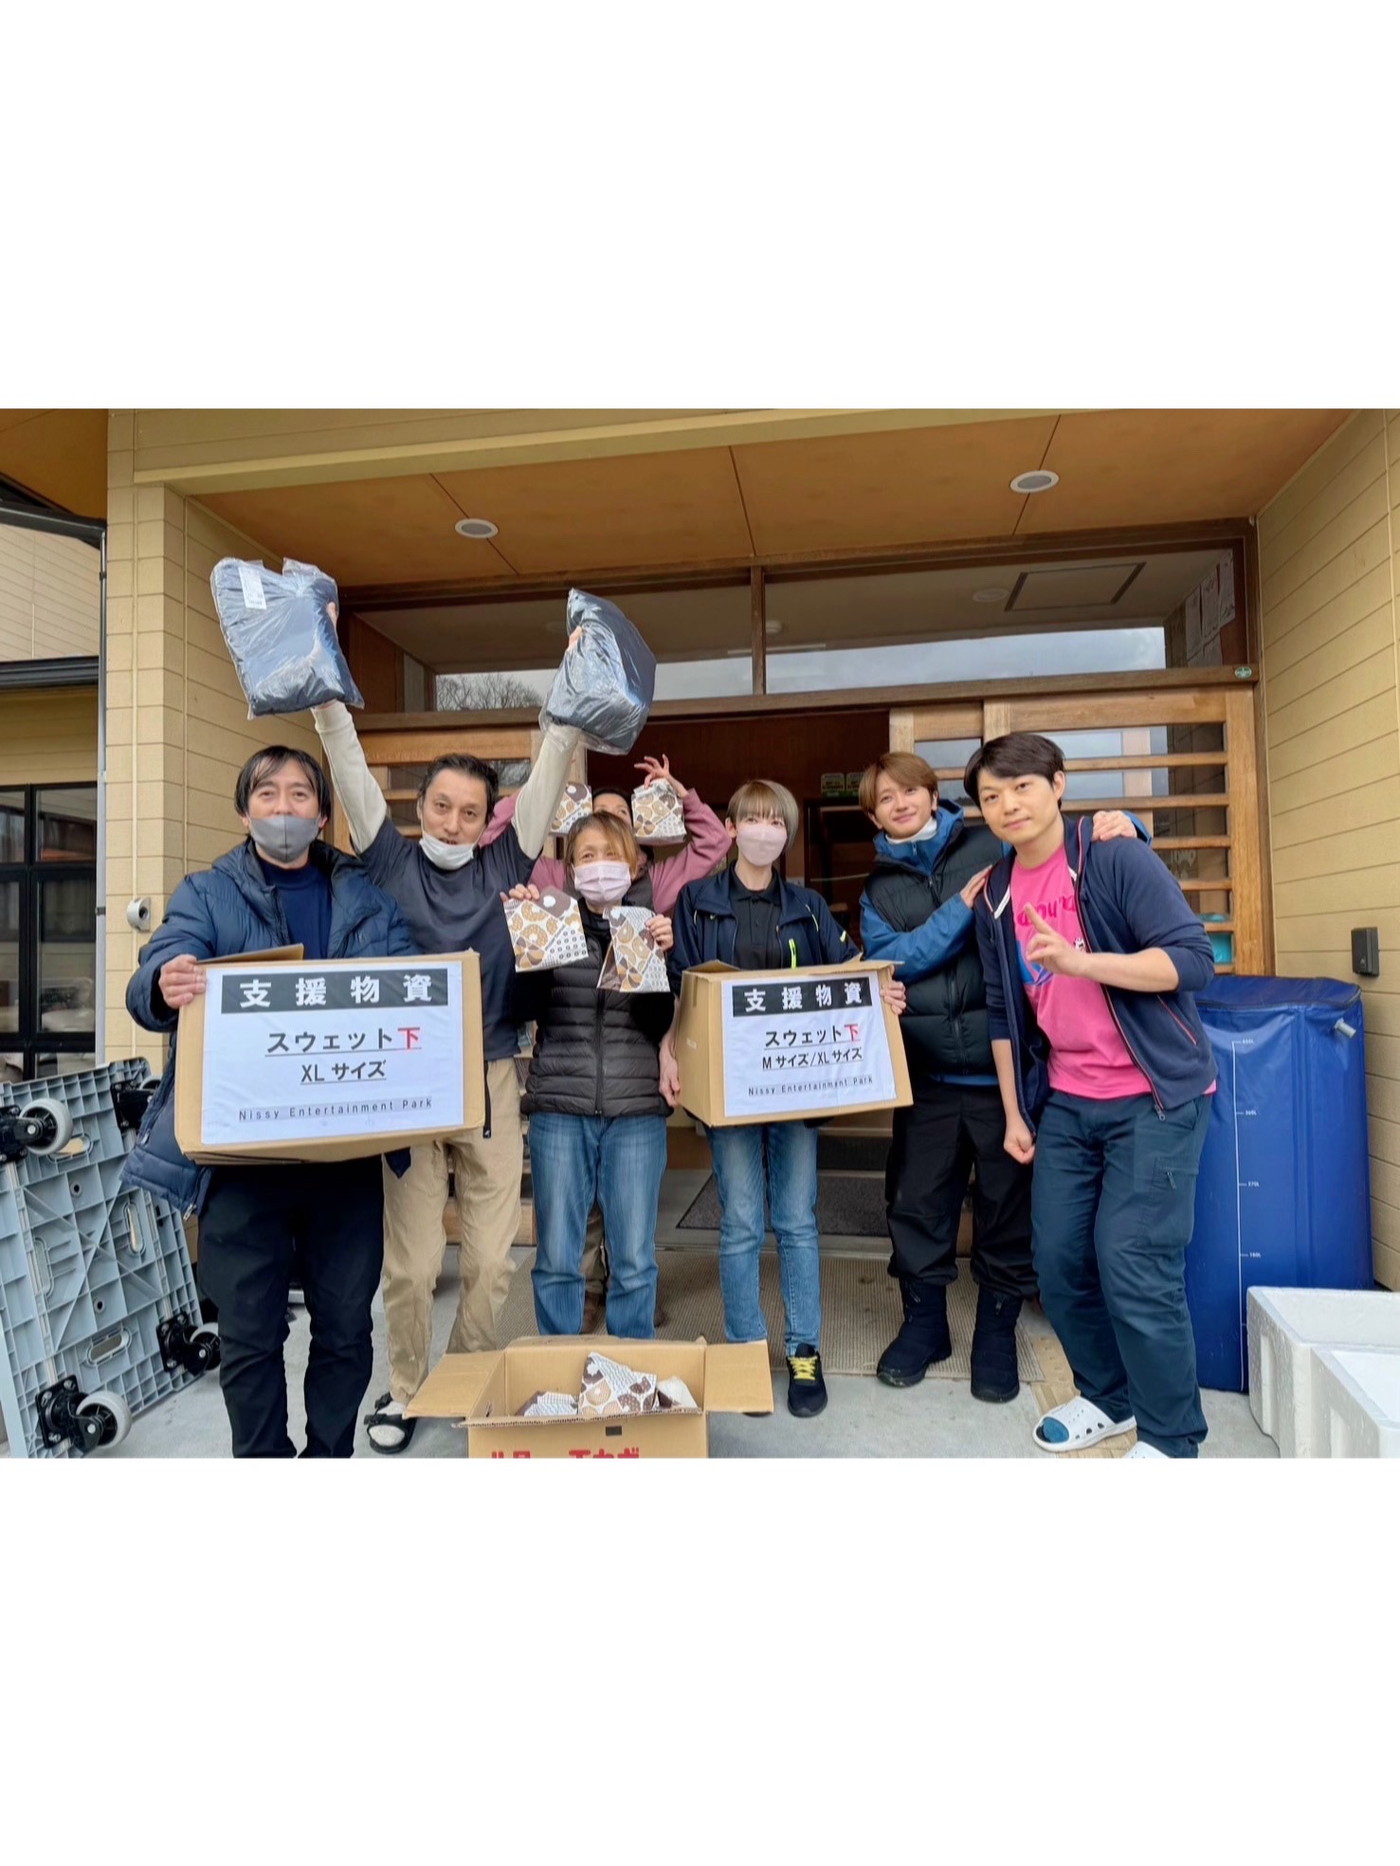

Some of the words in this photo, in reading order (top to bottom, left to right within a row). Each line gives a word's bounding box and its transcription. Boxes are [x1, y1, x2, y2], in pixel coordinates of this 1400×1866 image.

[239, 974, 432, 1009] 支援物資
[744, 981, 863, 1013] 支援物資
[267, 1026, 421, 1053] スウェット下
[765, 1023, 859, 1047] スウェット下
[748, 1087, 776, 1096] Nissy
[781, 1079, 848, 1093] Entertainment
[853, 1075, 873, 1085] Park
[239, 1110, 280, 1121] Nissy
[289, 1102, 394, 1117] Entertainment
[402, 1097, 433, 1109] Park
